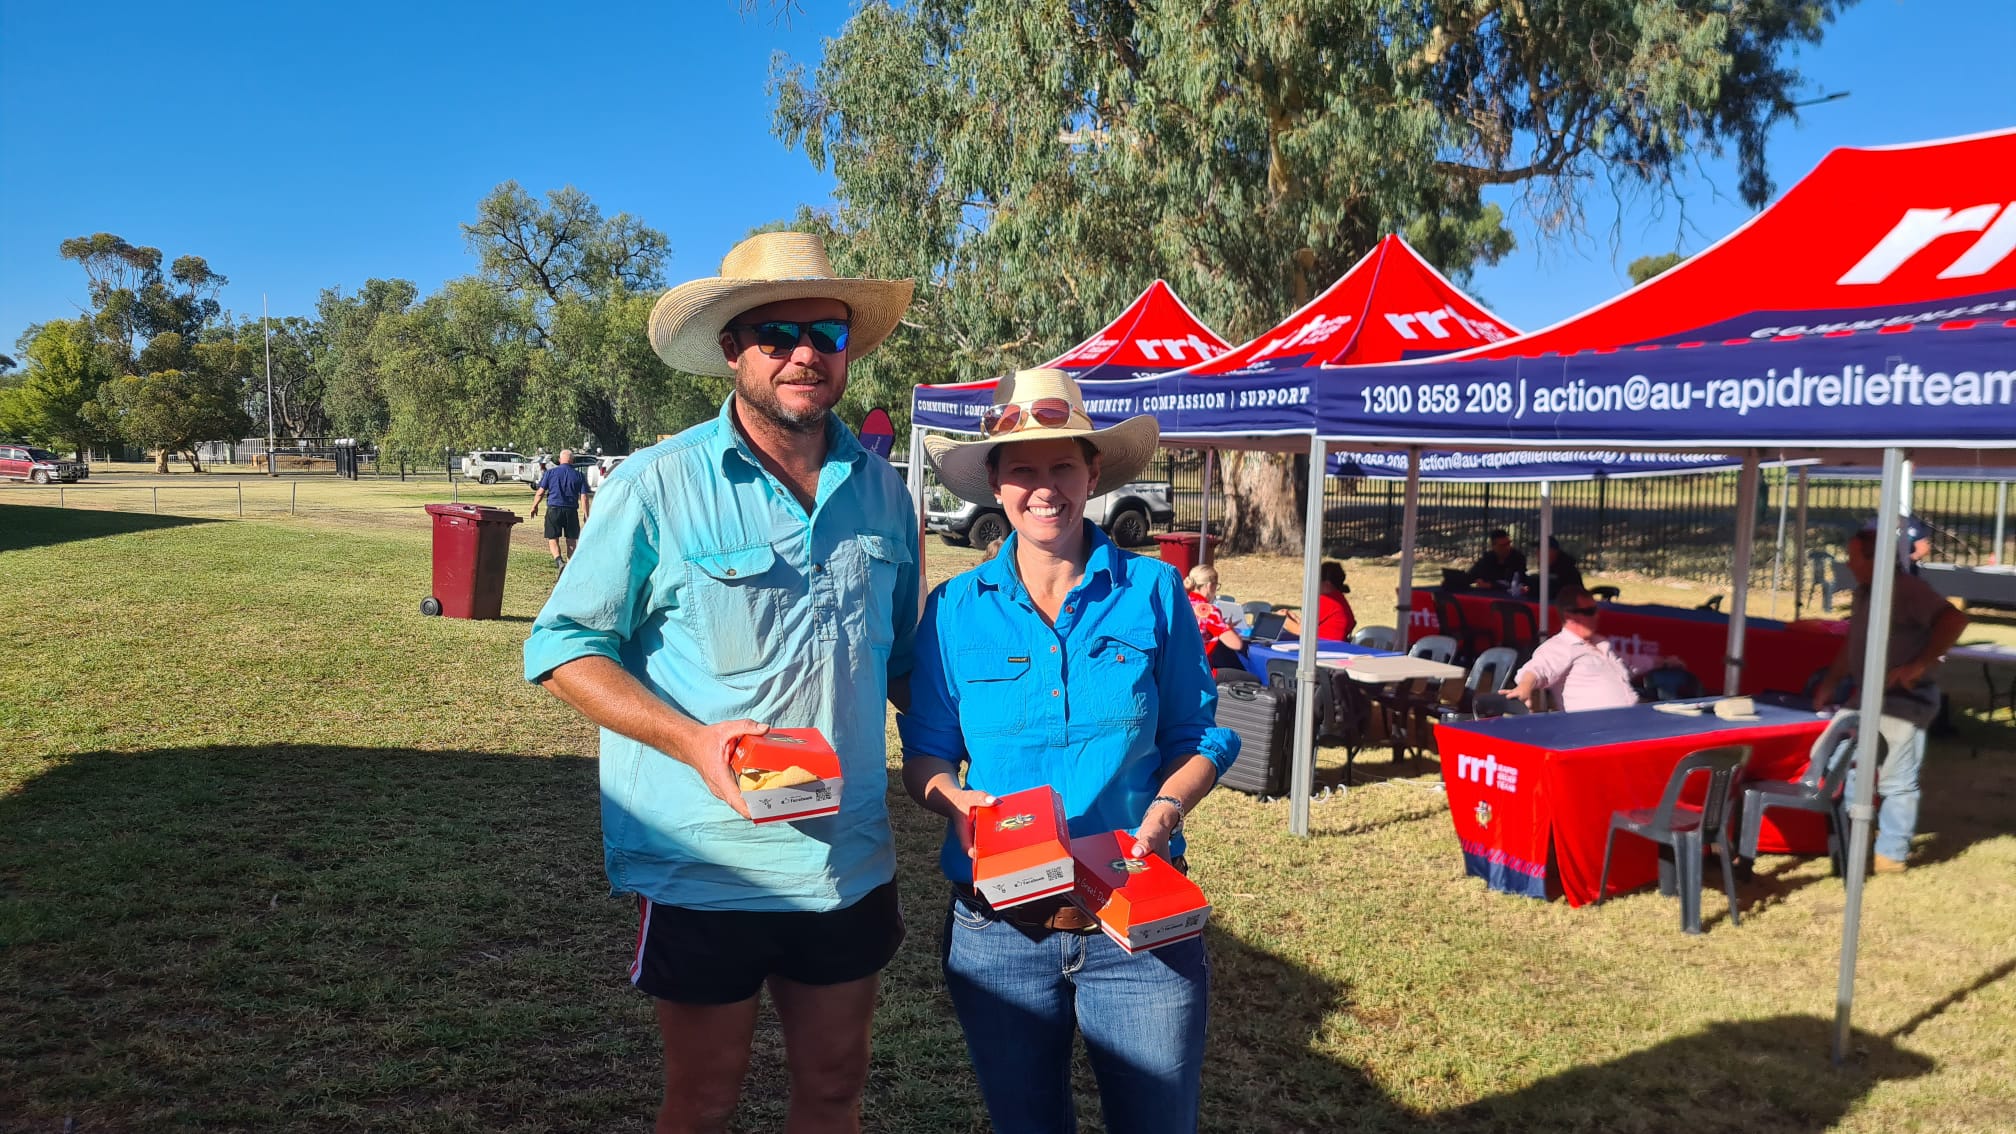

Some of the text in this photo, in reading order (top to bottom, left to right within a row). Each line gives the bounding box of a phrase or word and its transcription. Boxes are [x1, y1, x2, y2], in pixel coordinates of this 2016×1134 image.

[1135, 333, 1214, 361] rrt
[917, 400, 958, 416] COMMUNITY
[1082, 398, 1132, 413] MMUNITY
[1143, 392, 1225, 411] COMPASSION
[1239, 386, 1310, 406] SUPPORT
[1361, 385, 1412, 413] 1300
[1417, 384, 1460, 413] 858
[1465, 382, 1511, 413] 208
[1458, 754, 1497, 787] rrt
